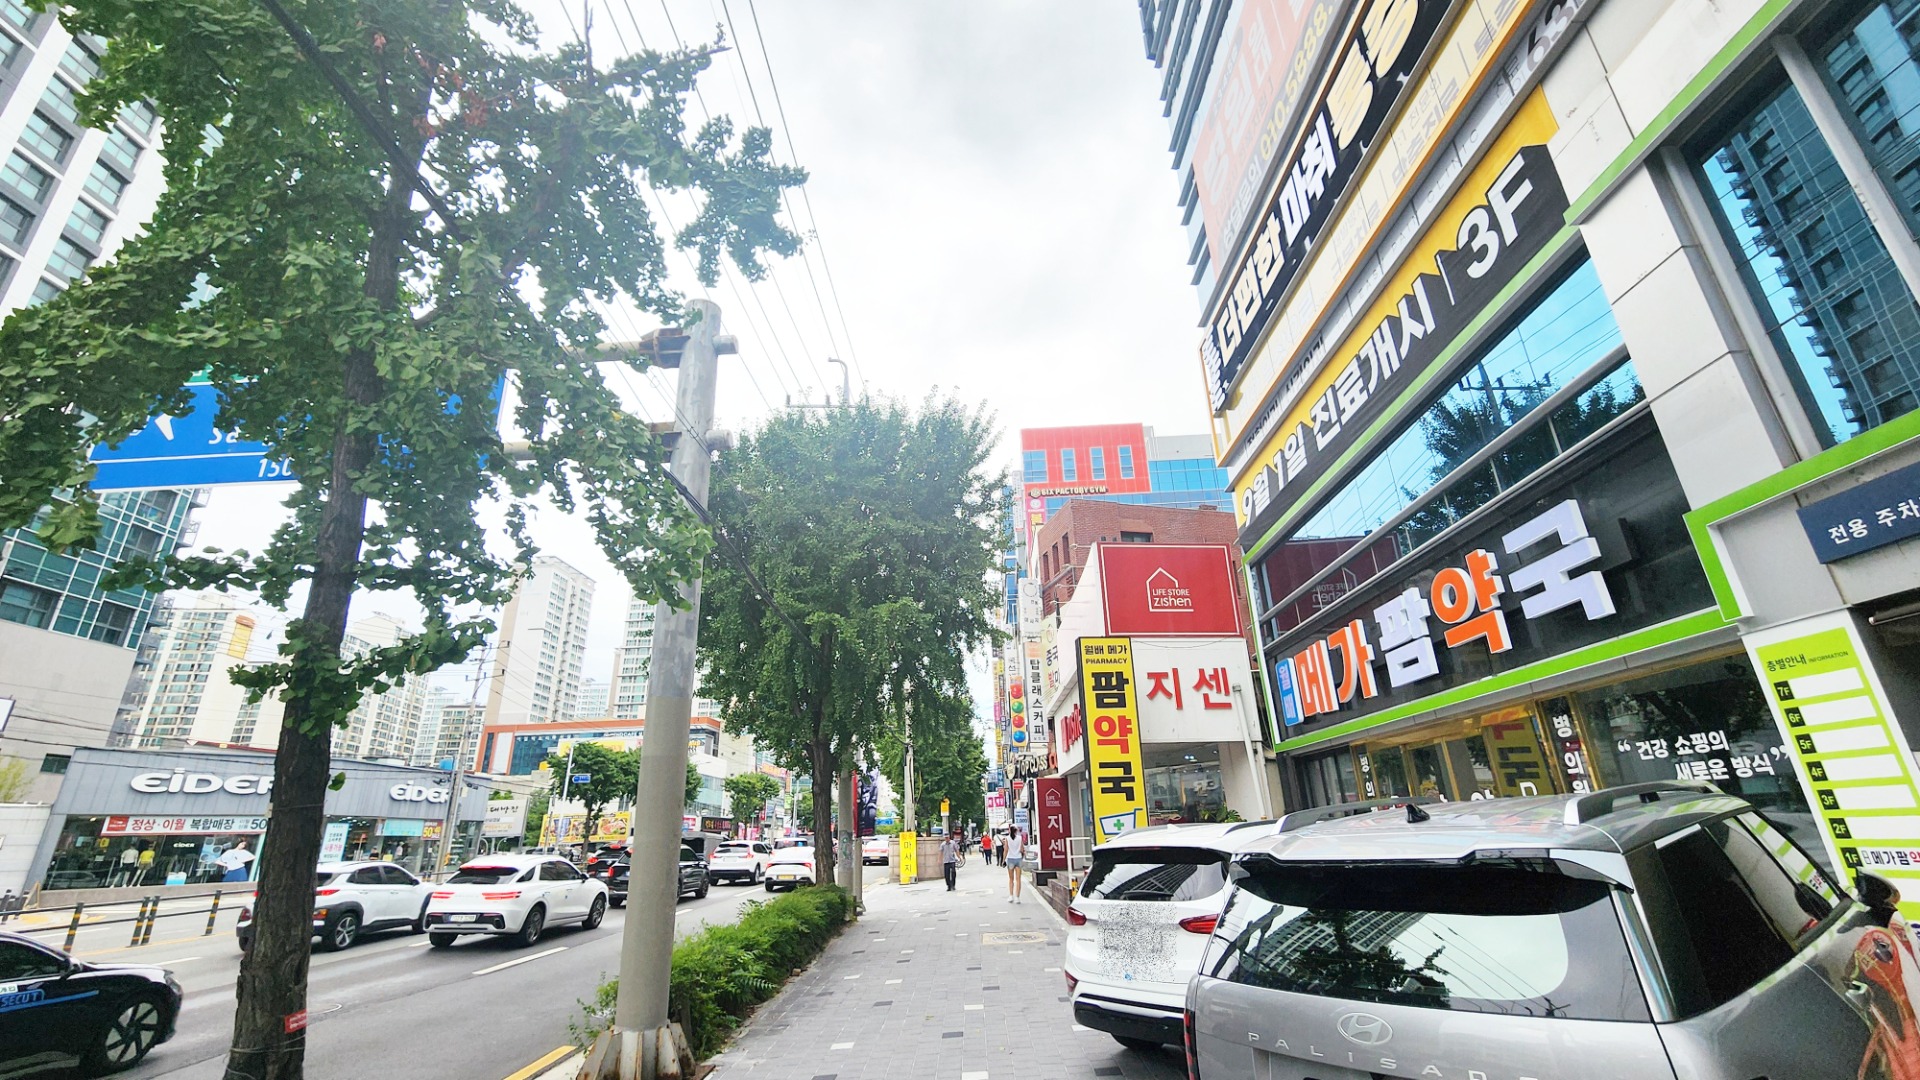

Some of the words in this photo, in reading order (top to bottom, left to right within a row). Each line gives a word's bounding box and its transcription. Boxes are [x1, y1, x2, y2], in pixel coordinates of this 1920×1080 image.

[1216, 211, 1285, 367] 더편한
[1279, 111, 1337, 247] 마취
[1241, 470, 1271, 526] 9월
[1272, 427, 1308, 492] 1일
[1310, 277, 1436, 452] 진료개시
[1457, 155, 1534, 279] 3F
[1089, 485, 1106, 494] GYM
[1828, 517, 1868, 545] 전용
[1875, 496, 1920, 528] 주차
[1152, 588, 1166, 597] LIFE
[1168, 588, 1190, 597] STORE
[1154, 596, 1192, 607] zishen
[1294, 498, 1617, 718] 메가팜약국
[1107, 644, 1128, 655] 메가
[1085, 656, 1128, 665] PHARMACY
[1766, 654, 1807, 672] 층별안내
[1808, 651, 1849, 663] INFORMATION
[1146, 667, 1233, 711] 지센
[1777, 686, 1791, 697] 7F
[1029, 659, 1045, 737] 탑클래스커피
[1788, 712, 1801, 723] 6F
[1091, 671, 1136, 802] 팜약국
[1673, 730, 1730, 756] 쇼핑의
[1800, 739, 1812, 750] 5F
[1674, 758, 1730, 781] 새로운
[1810, 766, 1824, 777] 4F
[1821, 794, 1835, 806] 3F
[189, 818, 235, 832] 복합매장
[1832, 823, 1847, 834] 2F
[1047, 813, 1066, 859] 지센
[903, 841, 912, 873] 마사지
[1845, 852, 1859, 864] 1F
[1248, 1032, 1538, 1080] PALISAD
